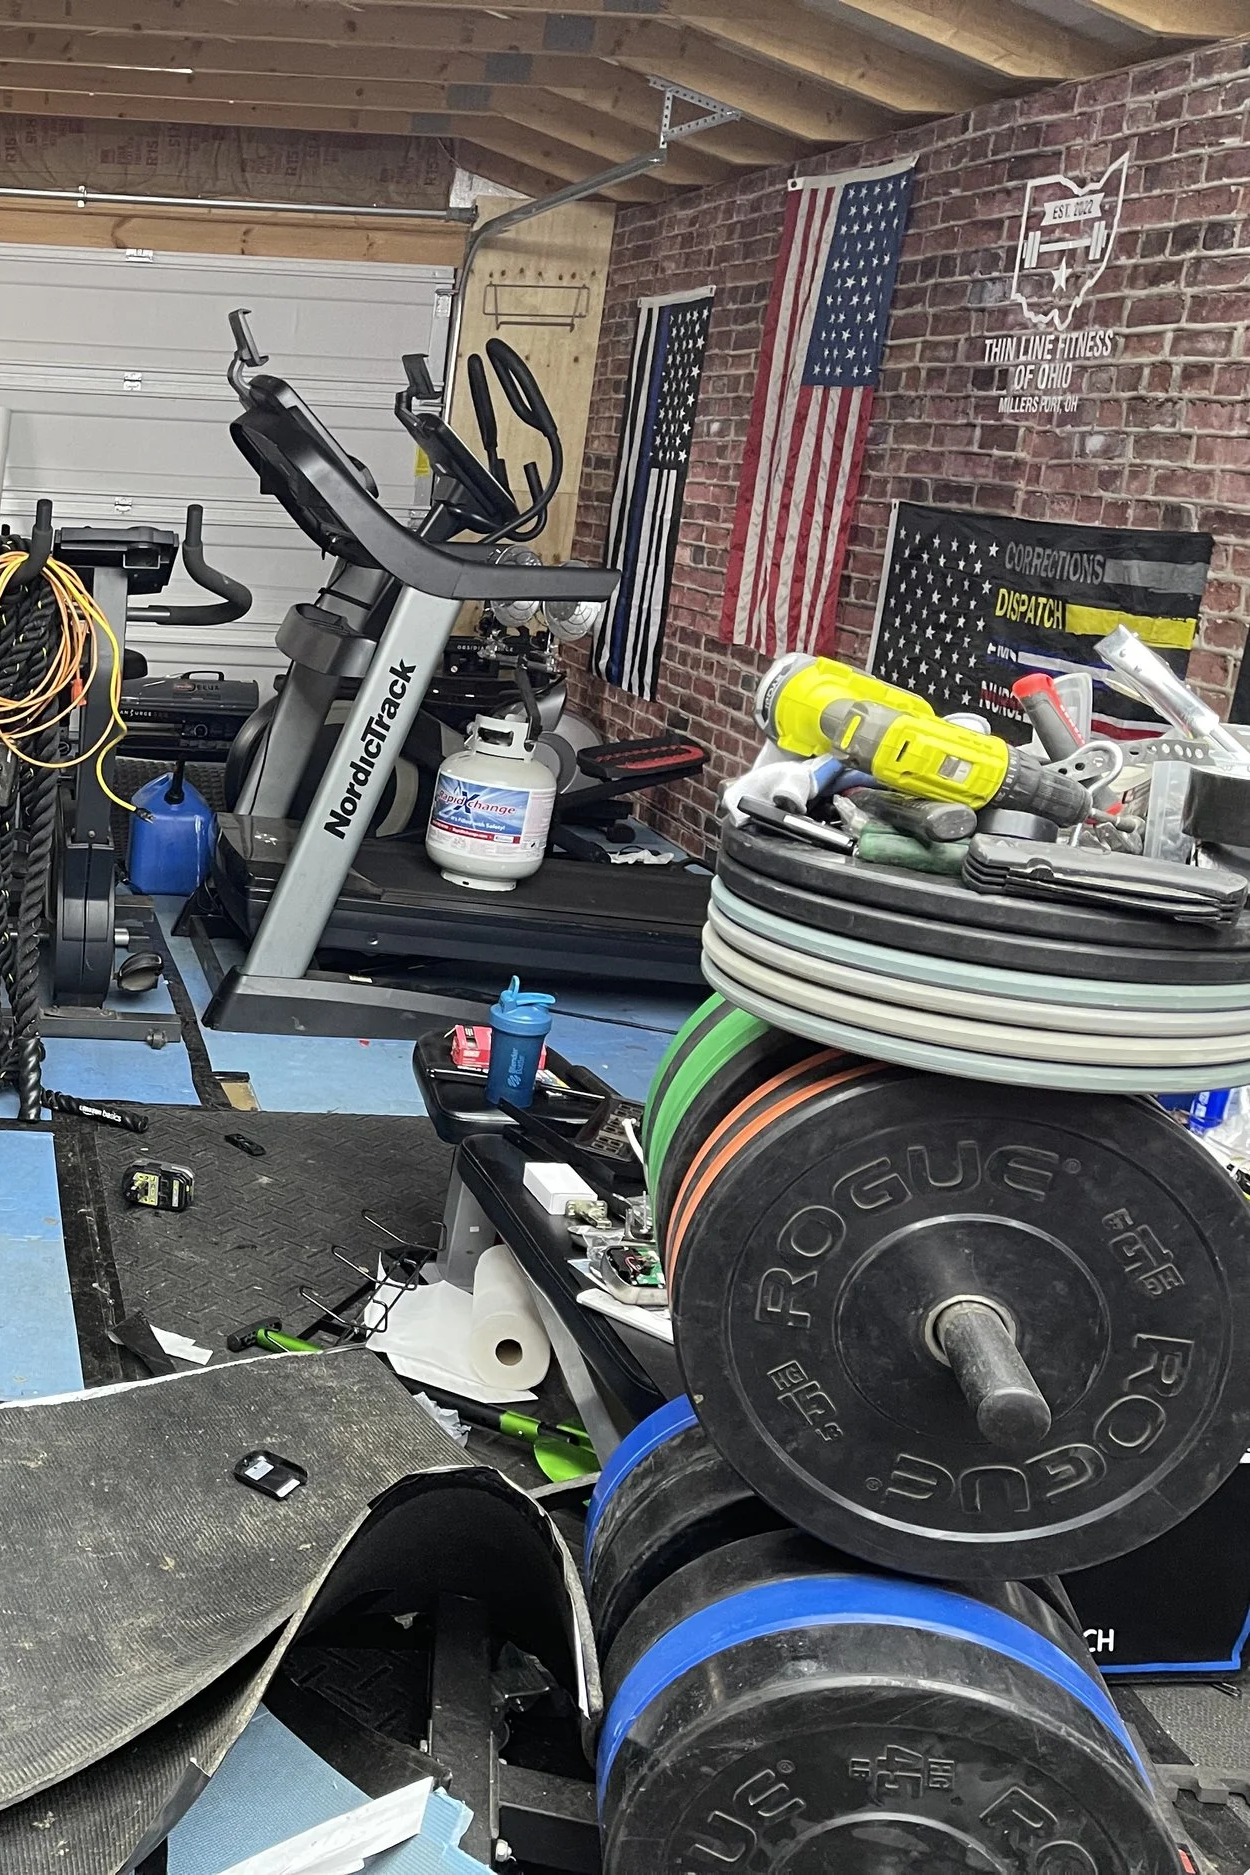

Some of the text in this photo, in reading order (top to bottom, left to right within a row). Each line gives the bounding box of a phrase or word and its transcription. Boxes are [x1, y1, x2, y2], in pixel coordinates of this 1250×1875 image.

[1053, 203, 1071, 220] EST.
[984, 329, 1114, 364] THIN LINE FITNESS
[1014, 362, 1073, 390] OF OHIO
[998, 396, 1039, 413] MILLERS
[1064, 395, 1079, 412] OH
[1004, 541, 1104, 586] CORRECTIONS
[994, 588, 1063, 630] DISPATCH
[323, 659, 417, 841] NordicTrack
[755, 1140, 1060, 1329] ROGUE
[768, 1360, 808, 1391] HG
[777, 1381, 837, 1426] 15
[885, 1333, 1195, 1515] ROGUE
